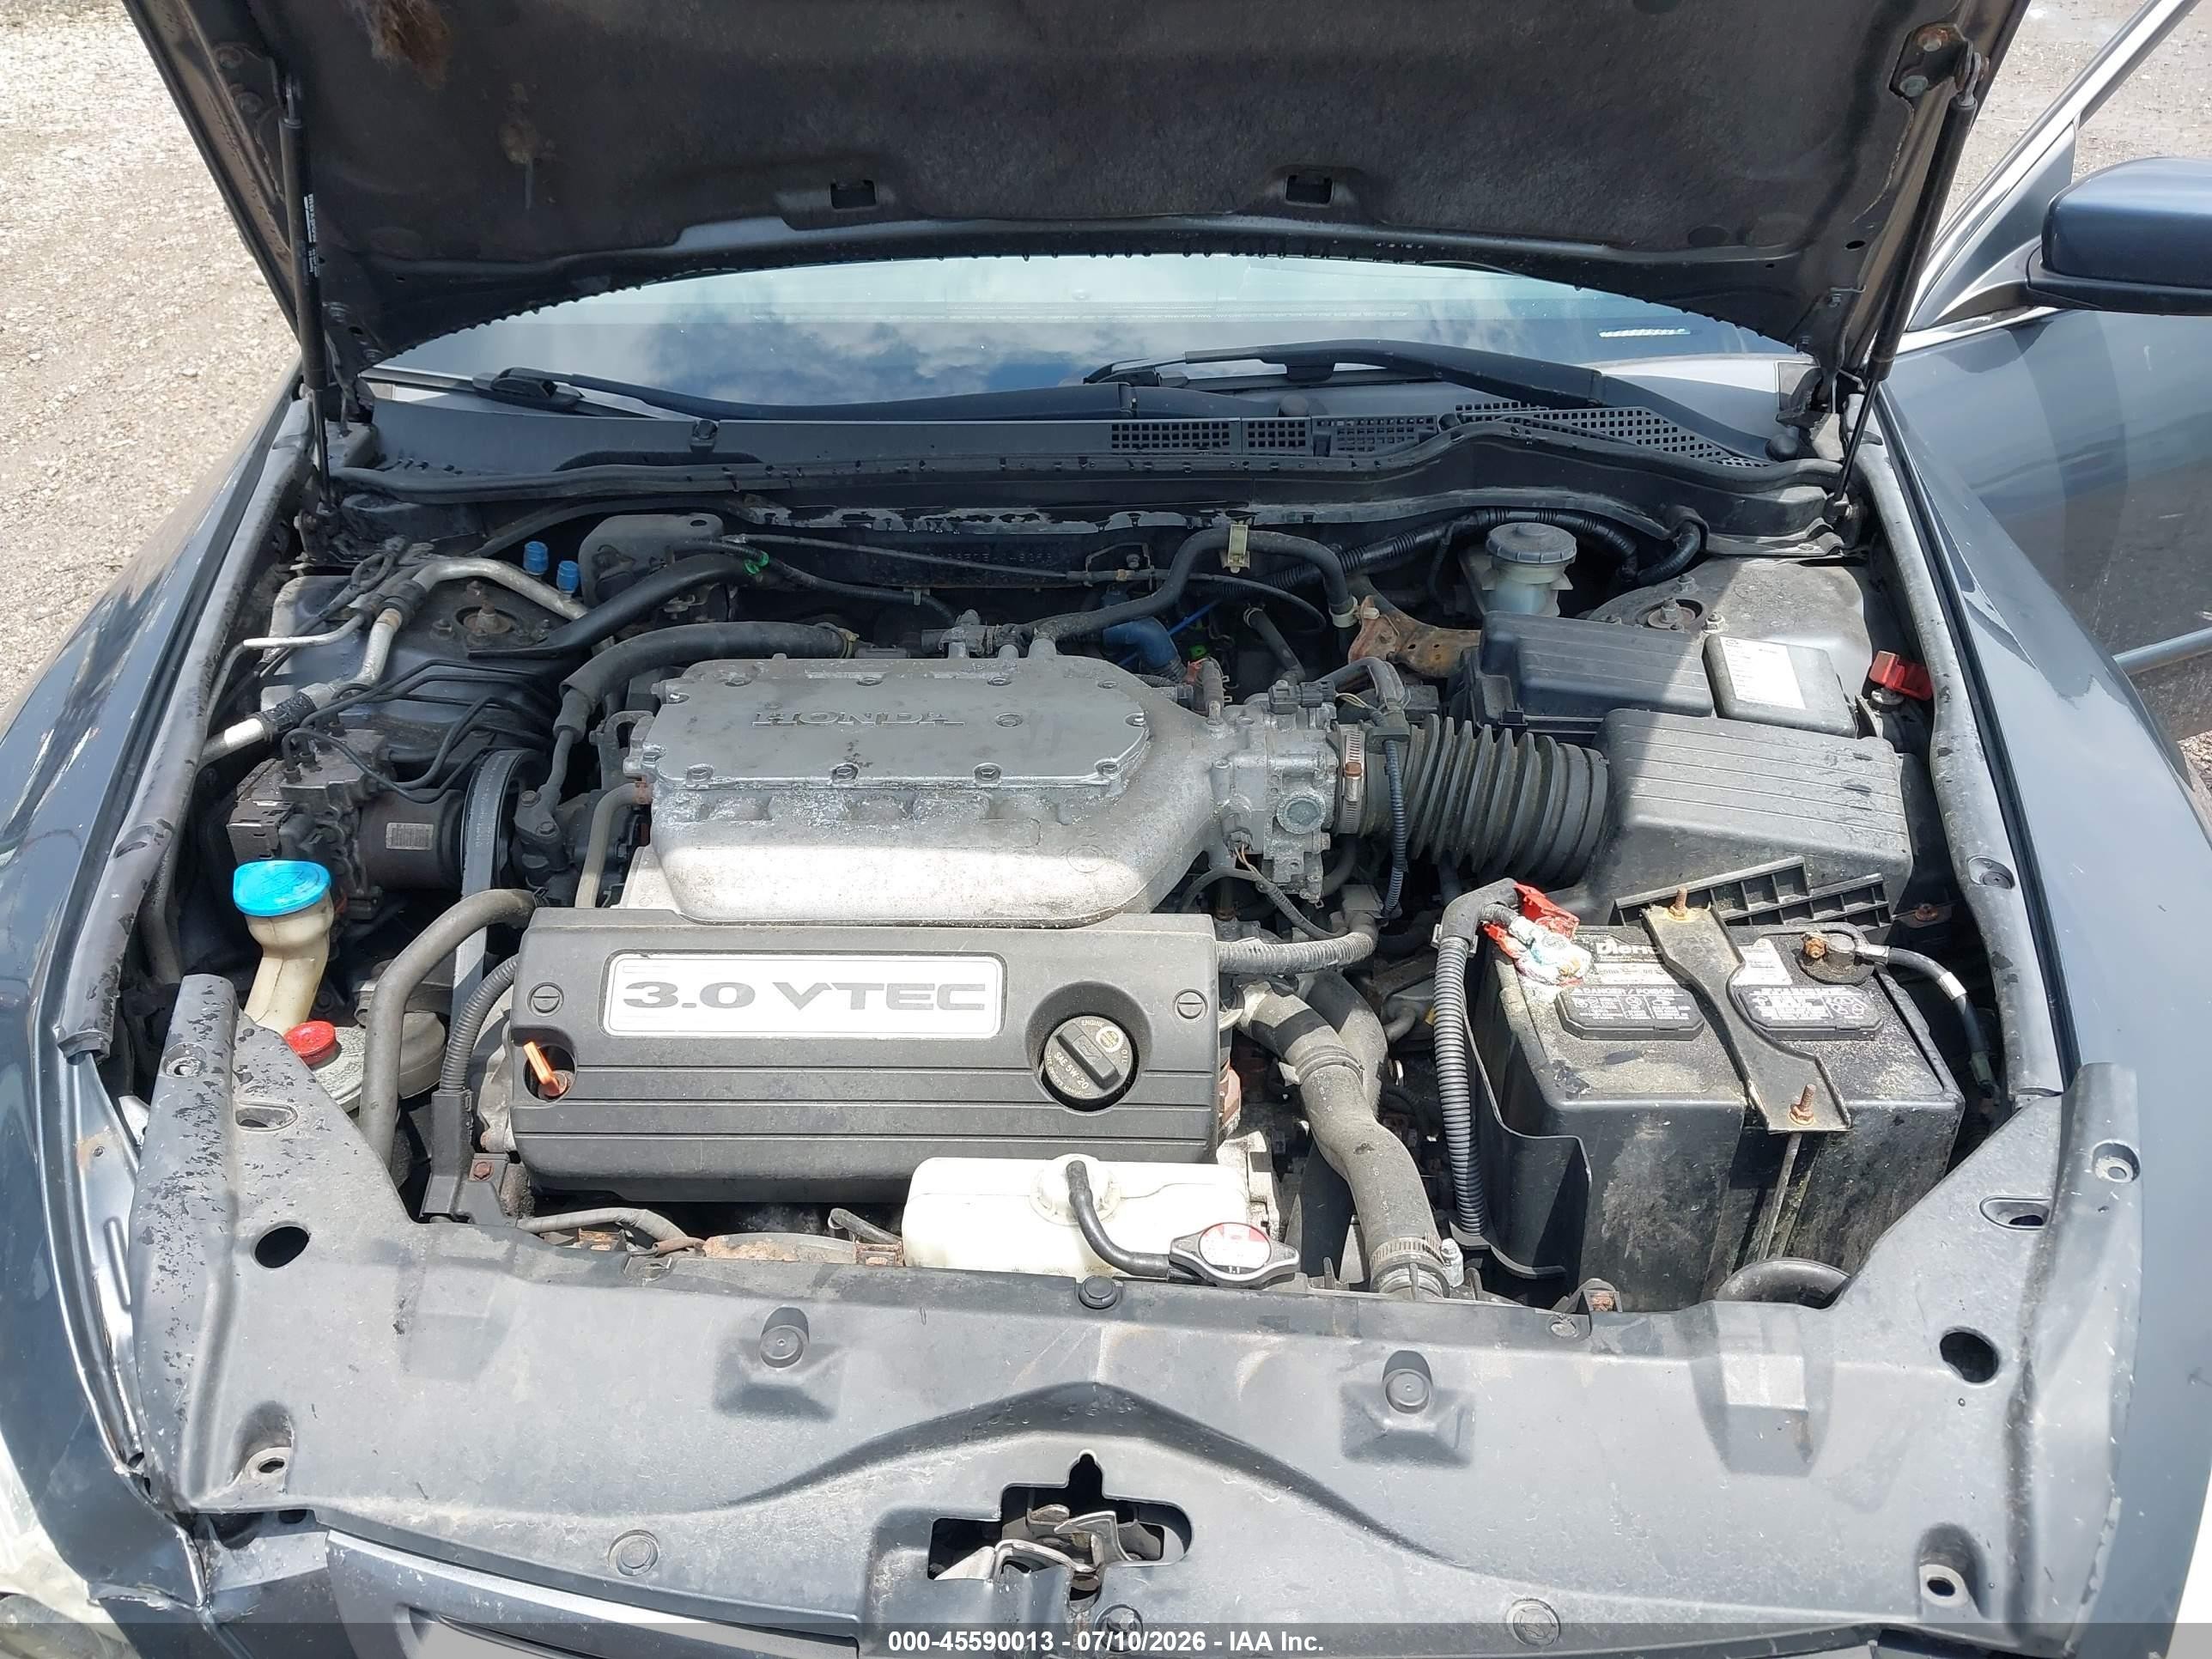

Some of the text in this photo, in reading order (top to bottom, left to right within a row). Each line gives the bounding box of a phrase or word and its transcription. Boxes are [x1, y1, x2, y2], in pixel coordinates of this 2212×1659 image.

[751, 712, 965, 727] HONDA
[623, 981, 985, 1011] 3.0 VTEC
[1054, 1051, 1090, 1090] SAE 5W-20
[1229, 1266, 1241, 1274] 1.1
